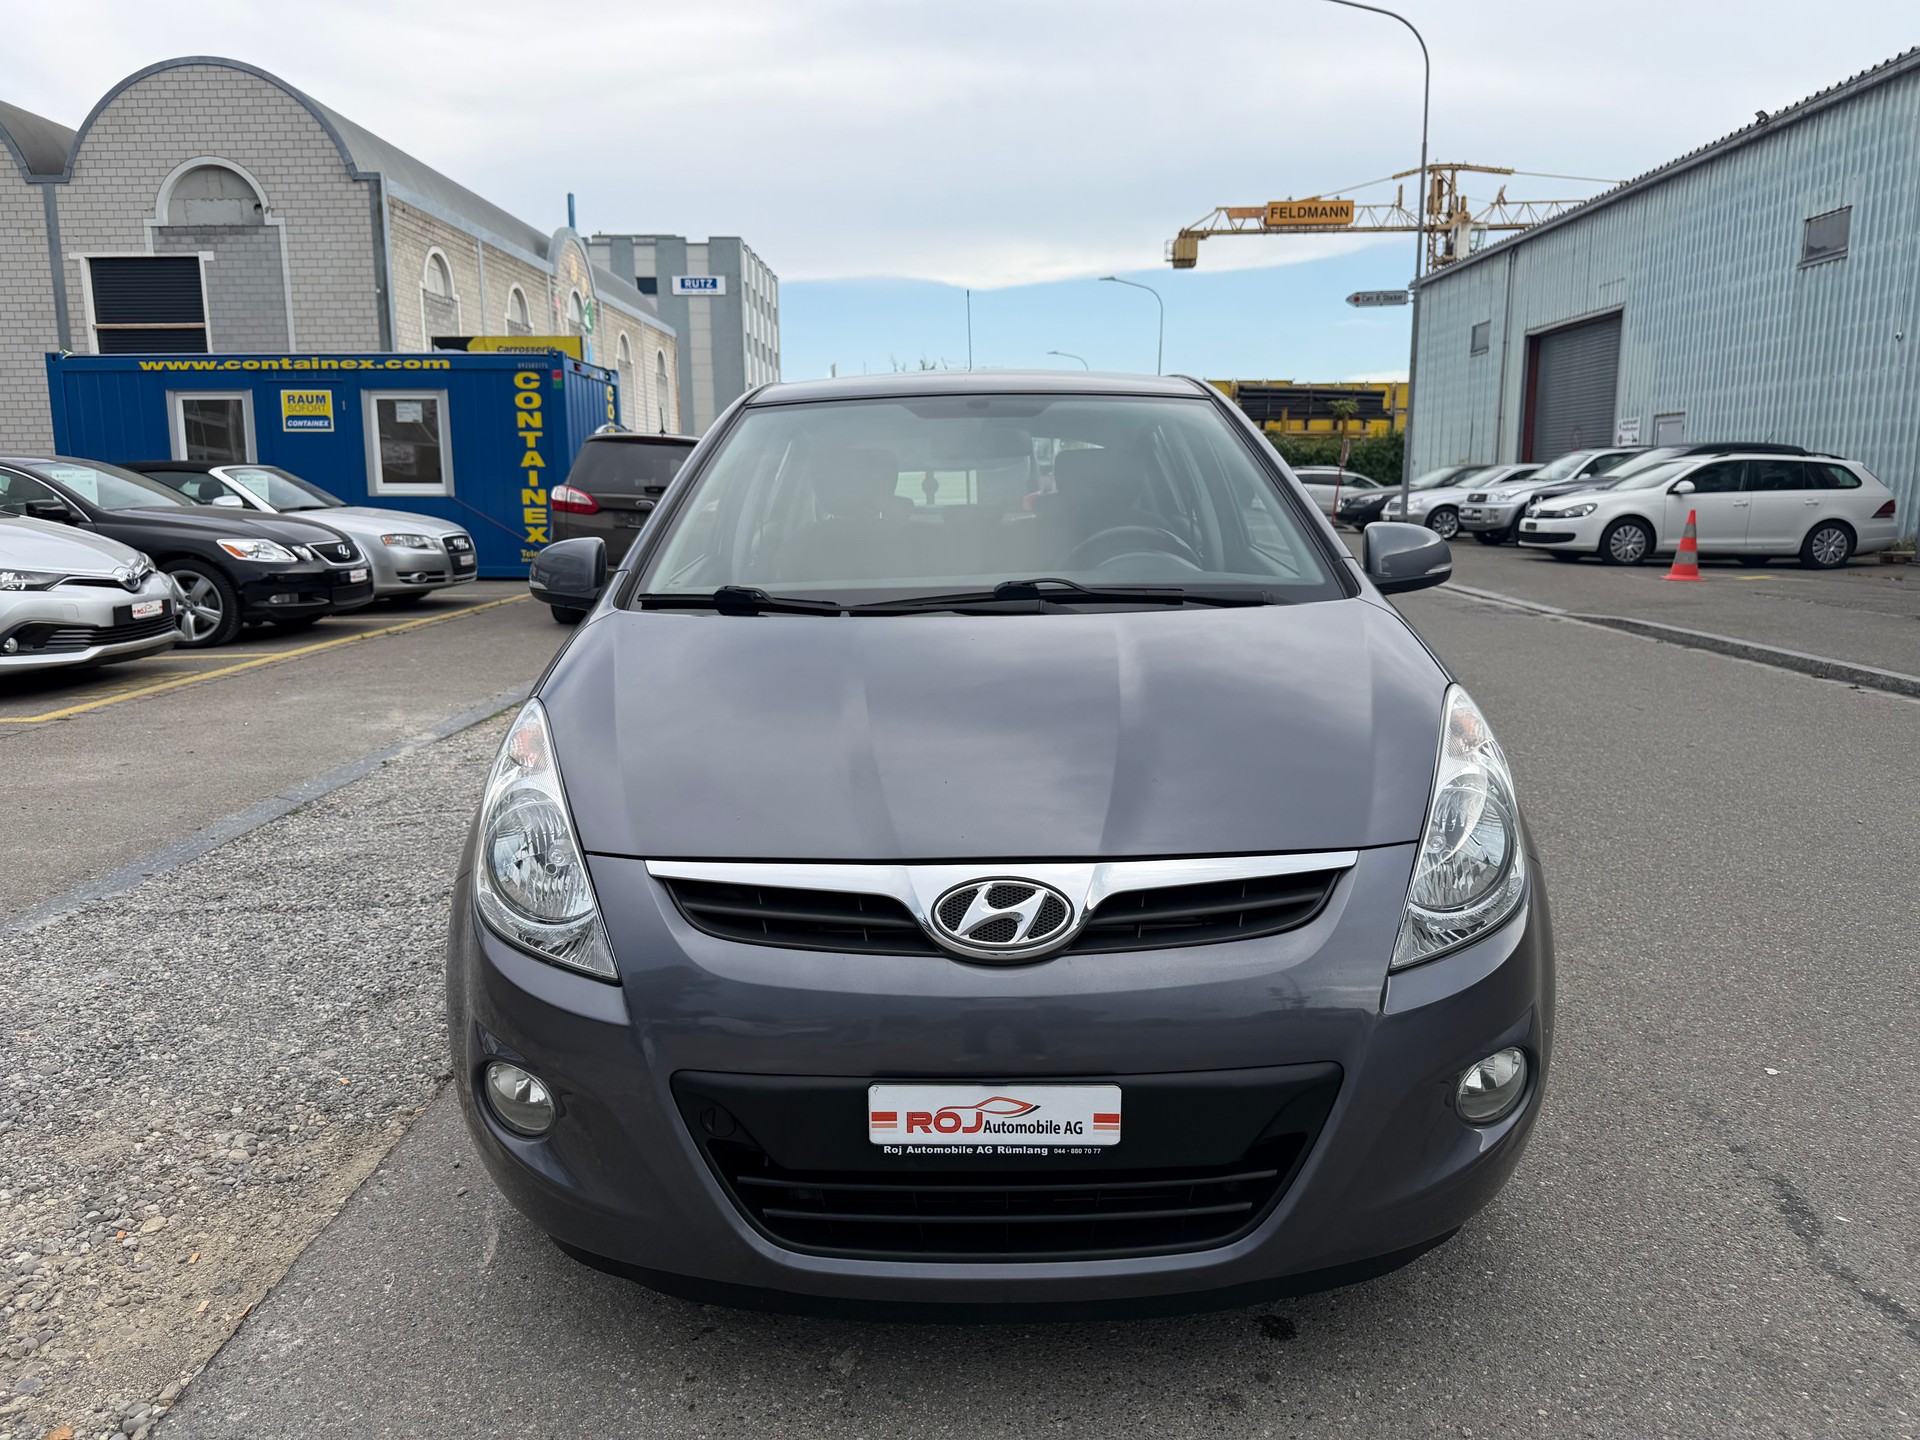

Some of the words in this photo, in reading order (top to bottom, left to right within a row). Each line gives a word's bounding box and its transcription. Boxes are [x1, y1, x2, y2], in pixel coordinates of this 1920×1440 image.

[1270, 206, 1349, 219] FELDMANN
[684, 279, 713, 289] RUTZ
[496, 344, 557, 353] Carrosserie
[138, 357, 450, 371] www.containex.com
[287, 394, 327, 405] RAUM
[287, 404, 326, 413] SOFORT
[287, 419, 330, 428] CONTAINEX
[514, 371, 550, 543] CONTAINEX
[906, 1111, 983, 1133] ROJ
[983, 1119, 1061, 1134] Automobile
[1064, 1121, 1083, 1134] AG
[883, 1145, 902, 1155] Roj
[906, 1145, 973, 1154] Automobile
[976, 1145, 993, 1154] AG
[997, 1145, 1048, 1156] Rümlang
